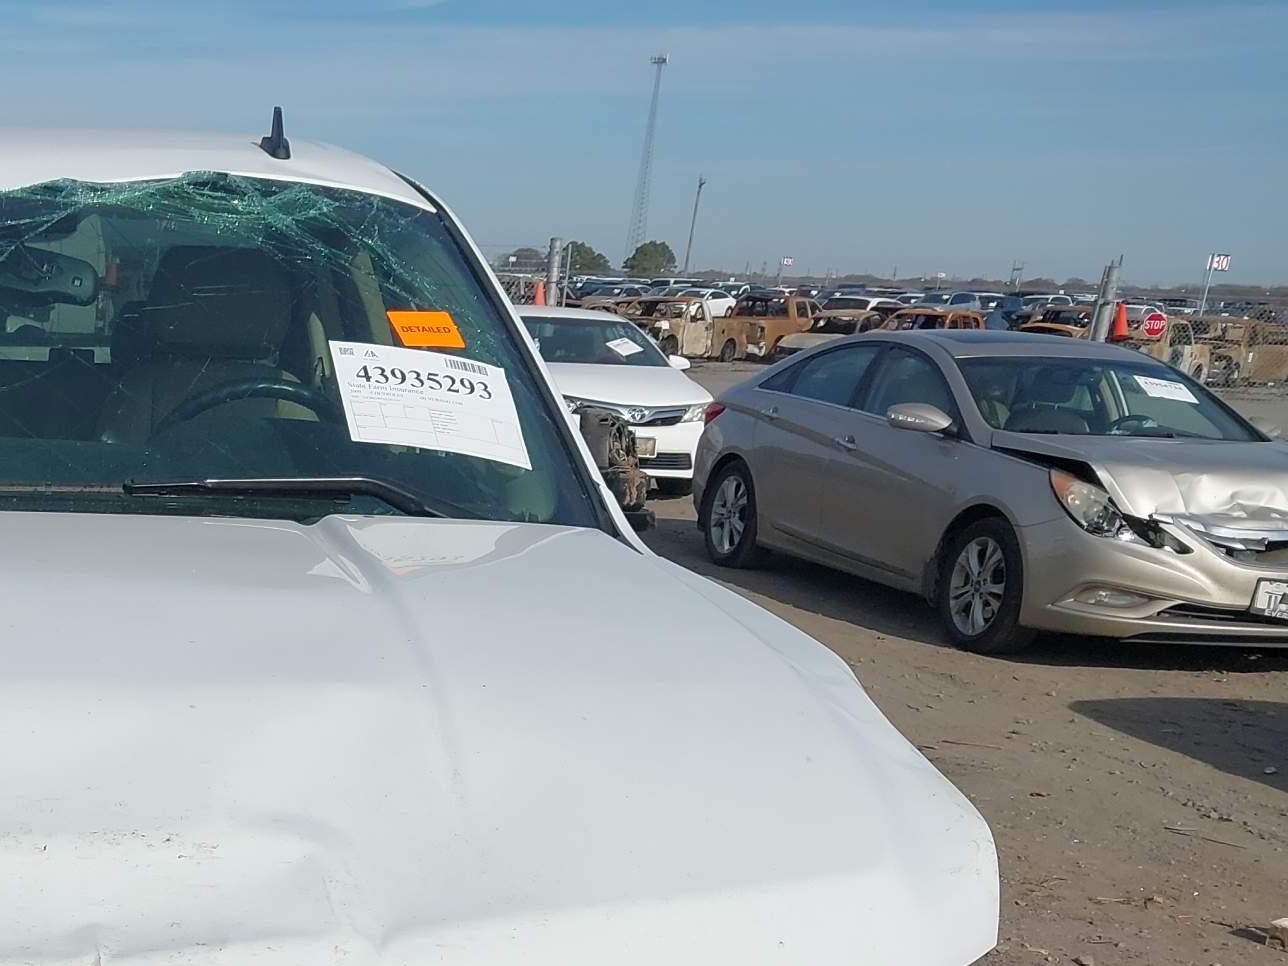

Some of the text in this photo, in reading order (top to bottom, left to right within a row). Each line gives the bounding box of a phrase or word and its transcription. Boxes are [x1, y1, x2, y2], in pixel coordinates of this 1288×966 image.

[400, 325, 451, 335] DETAILED
[1145, 320, 1166, 330] STOP
[355, 364, 493, 400] 43935293
